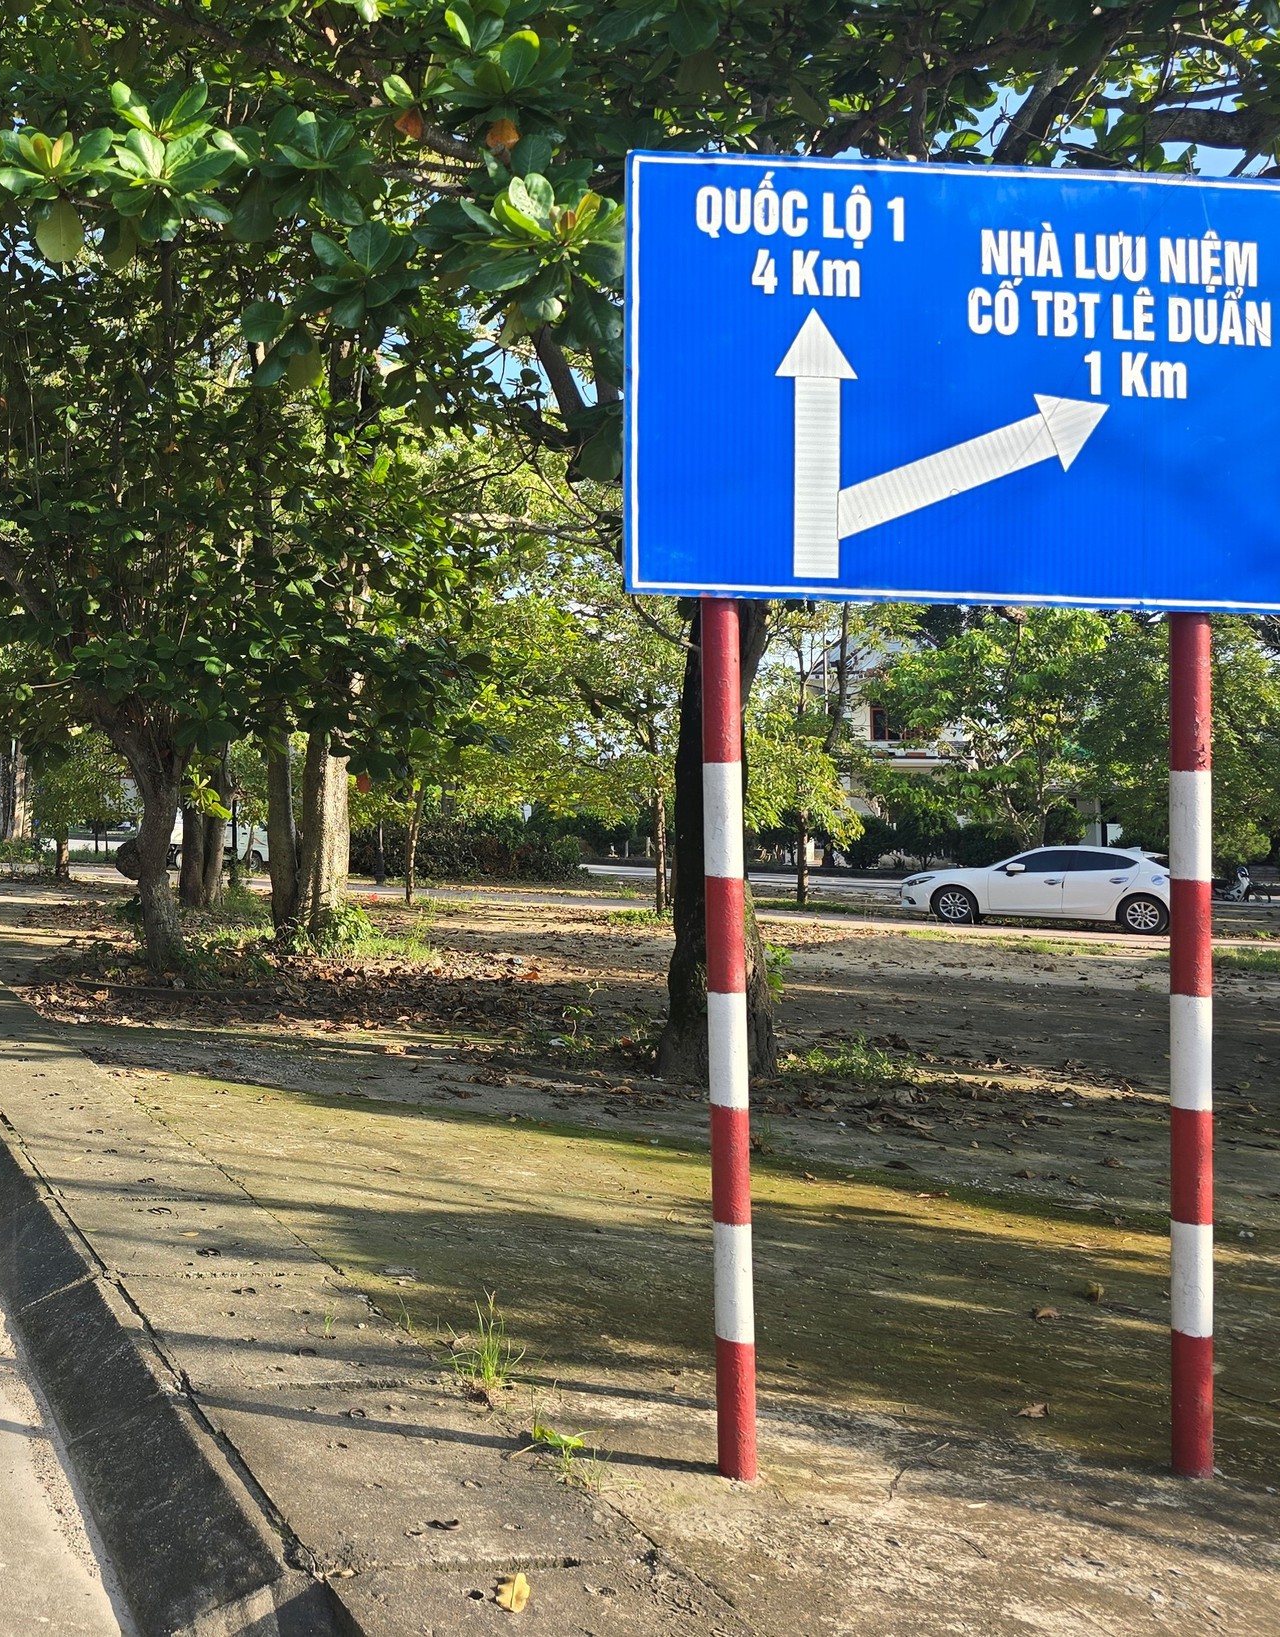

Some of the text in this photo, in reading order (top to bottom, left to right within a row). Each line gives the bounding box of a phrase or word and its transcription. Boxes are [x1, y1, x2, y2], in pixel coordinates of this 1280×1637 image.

[695, 171, 905, 250] QUỐC LỘ 1
[751, 248, 861, 298] 4 Km
[981, 222, 1258, 294] NHÀ LƯU NIỆM
[967, 276, 1272, 347] CỐ TBT LÊ DUẨN
[1084, 350, 1187, 400] 1 Km
